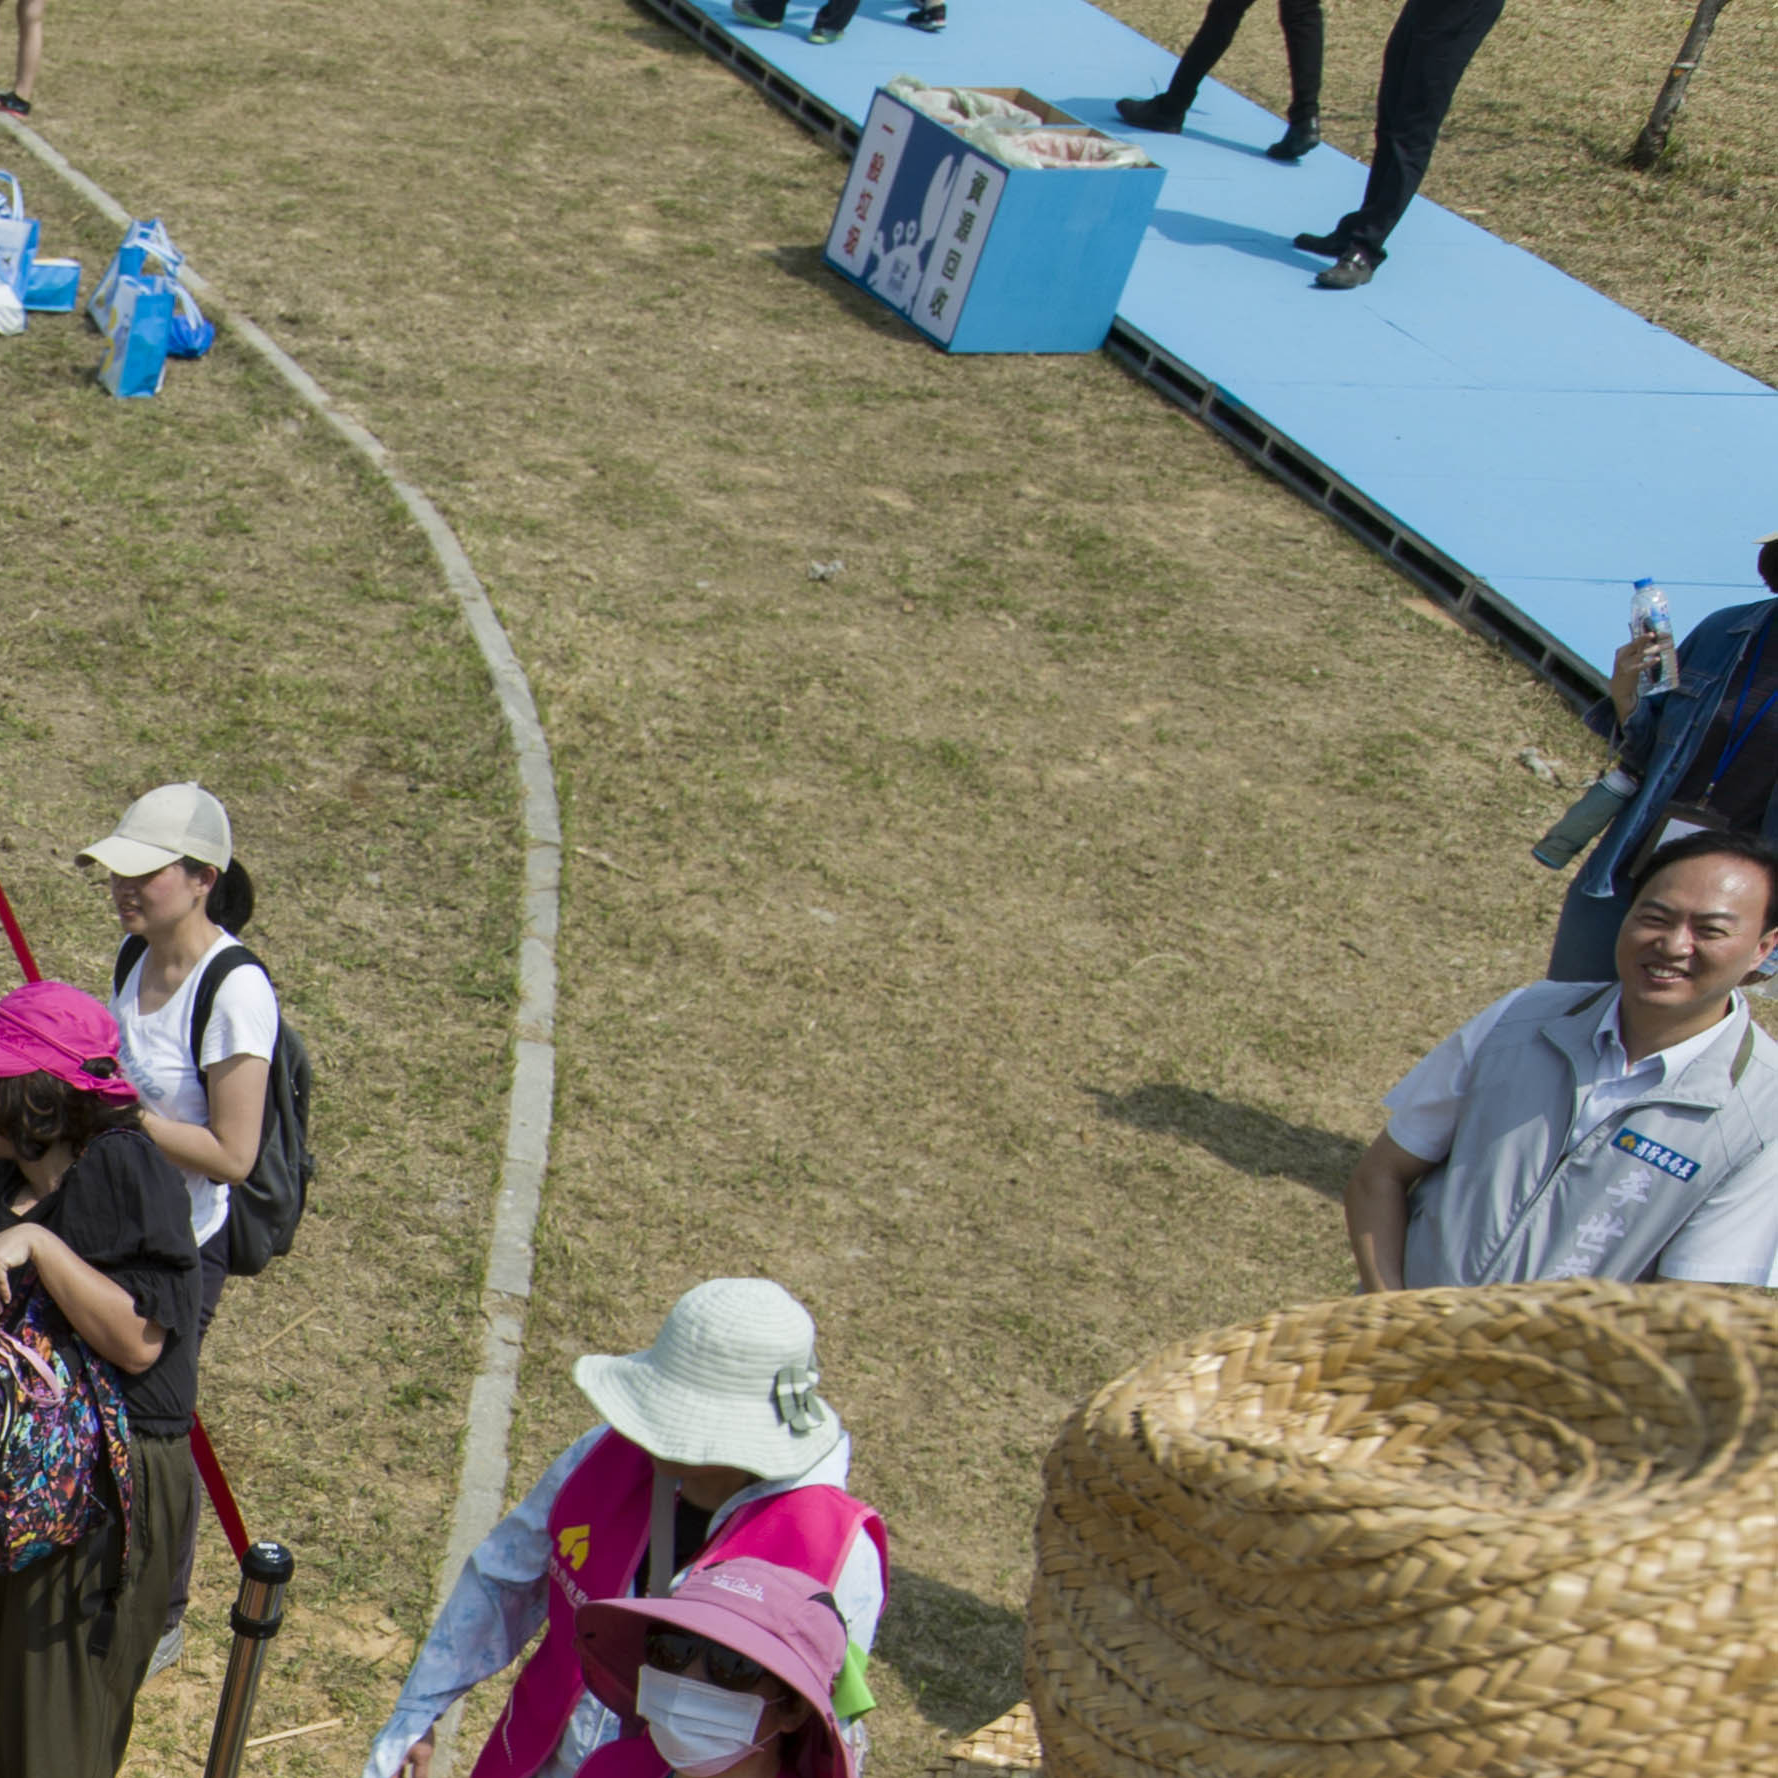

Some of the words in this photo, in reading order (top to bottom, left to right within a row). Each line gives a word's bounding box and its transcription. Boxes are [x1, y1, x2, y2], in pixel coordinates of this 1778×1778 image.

[842, 123, 897, 257] 一般垃圾
[928, 169, 990, 321] 資源回收
